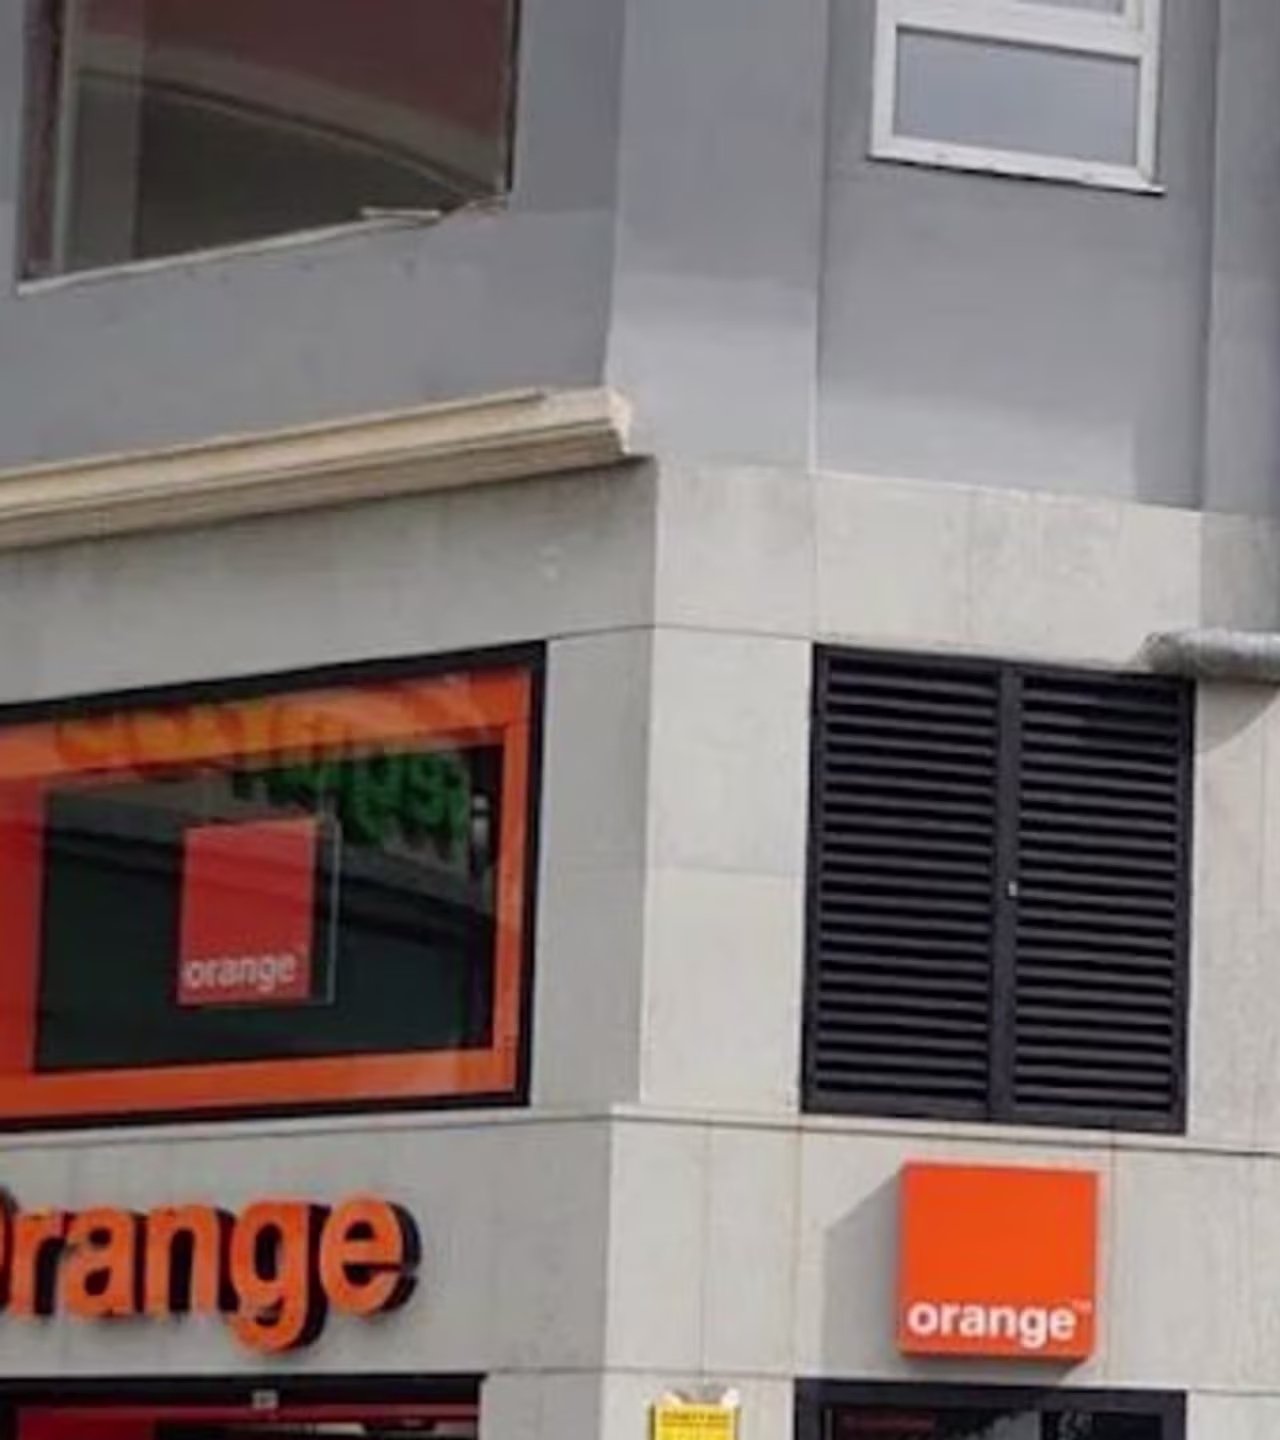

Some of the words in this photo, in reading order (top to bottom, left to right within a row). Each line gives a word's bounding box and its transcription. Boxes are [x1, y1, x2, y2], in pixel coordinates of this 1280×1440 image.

[184, 955, 296, 994] orange
[0, 1190, 412, 1353] range
[907, 1301, 1078, 1349] orange
